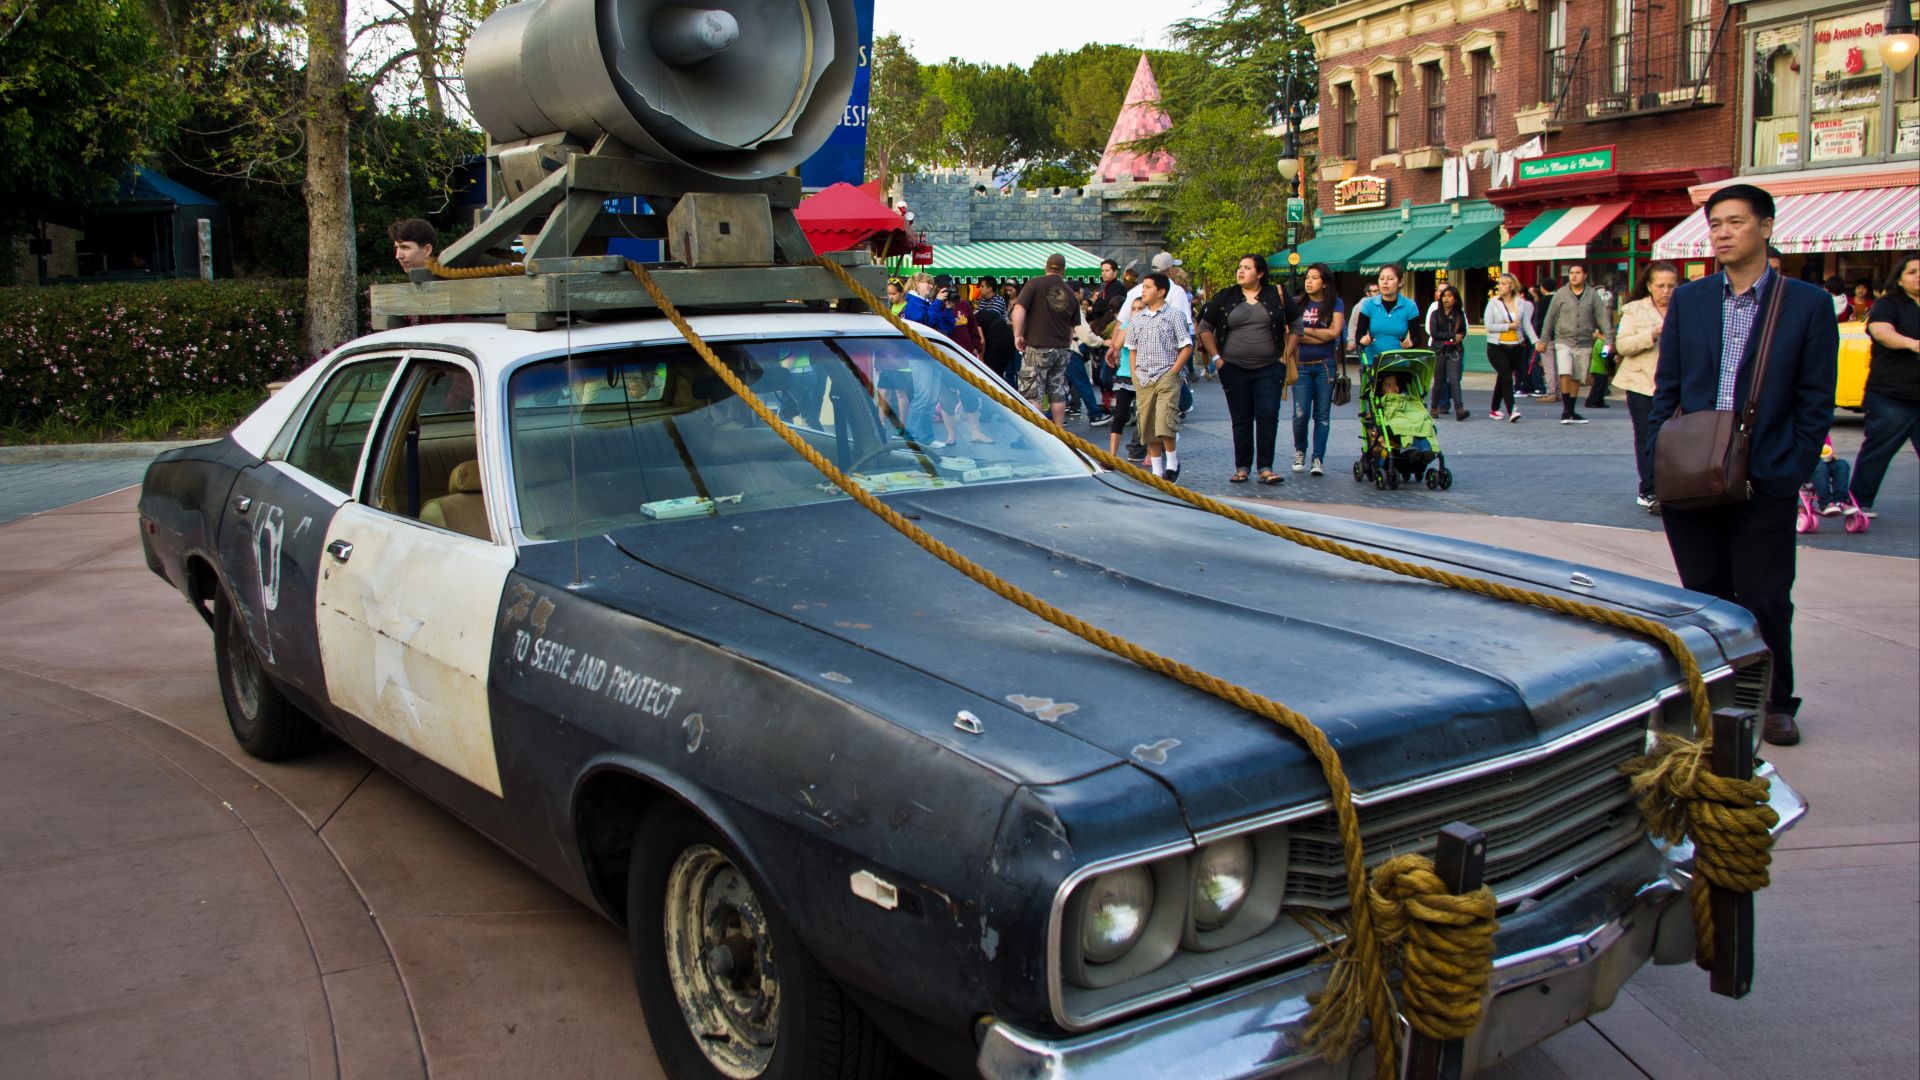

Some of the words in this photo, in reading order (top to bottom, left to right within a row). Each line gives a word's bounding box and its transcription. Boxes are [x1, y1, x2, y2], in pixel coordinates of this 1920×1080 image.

[1833, 28, 1862, 41] Avenue
[1865, 22, 1883, 37] Gym
[1825, 70, 1841, 81] Best
[1815, 84, 1838, 96] Boxing
[1813, 120, 1842, 129] BOXING
[1341, 180, 1380, 205] AMAZING
[513, 629, 531, 662] TO
[531, 638, 576, 680] SERVE
[570, 653, 608, 692] AND
[605, 665, 683, 719] PROTECT
